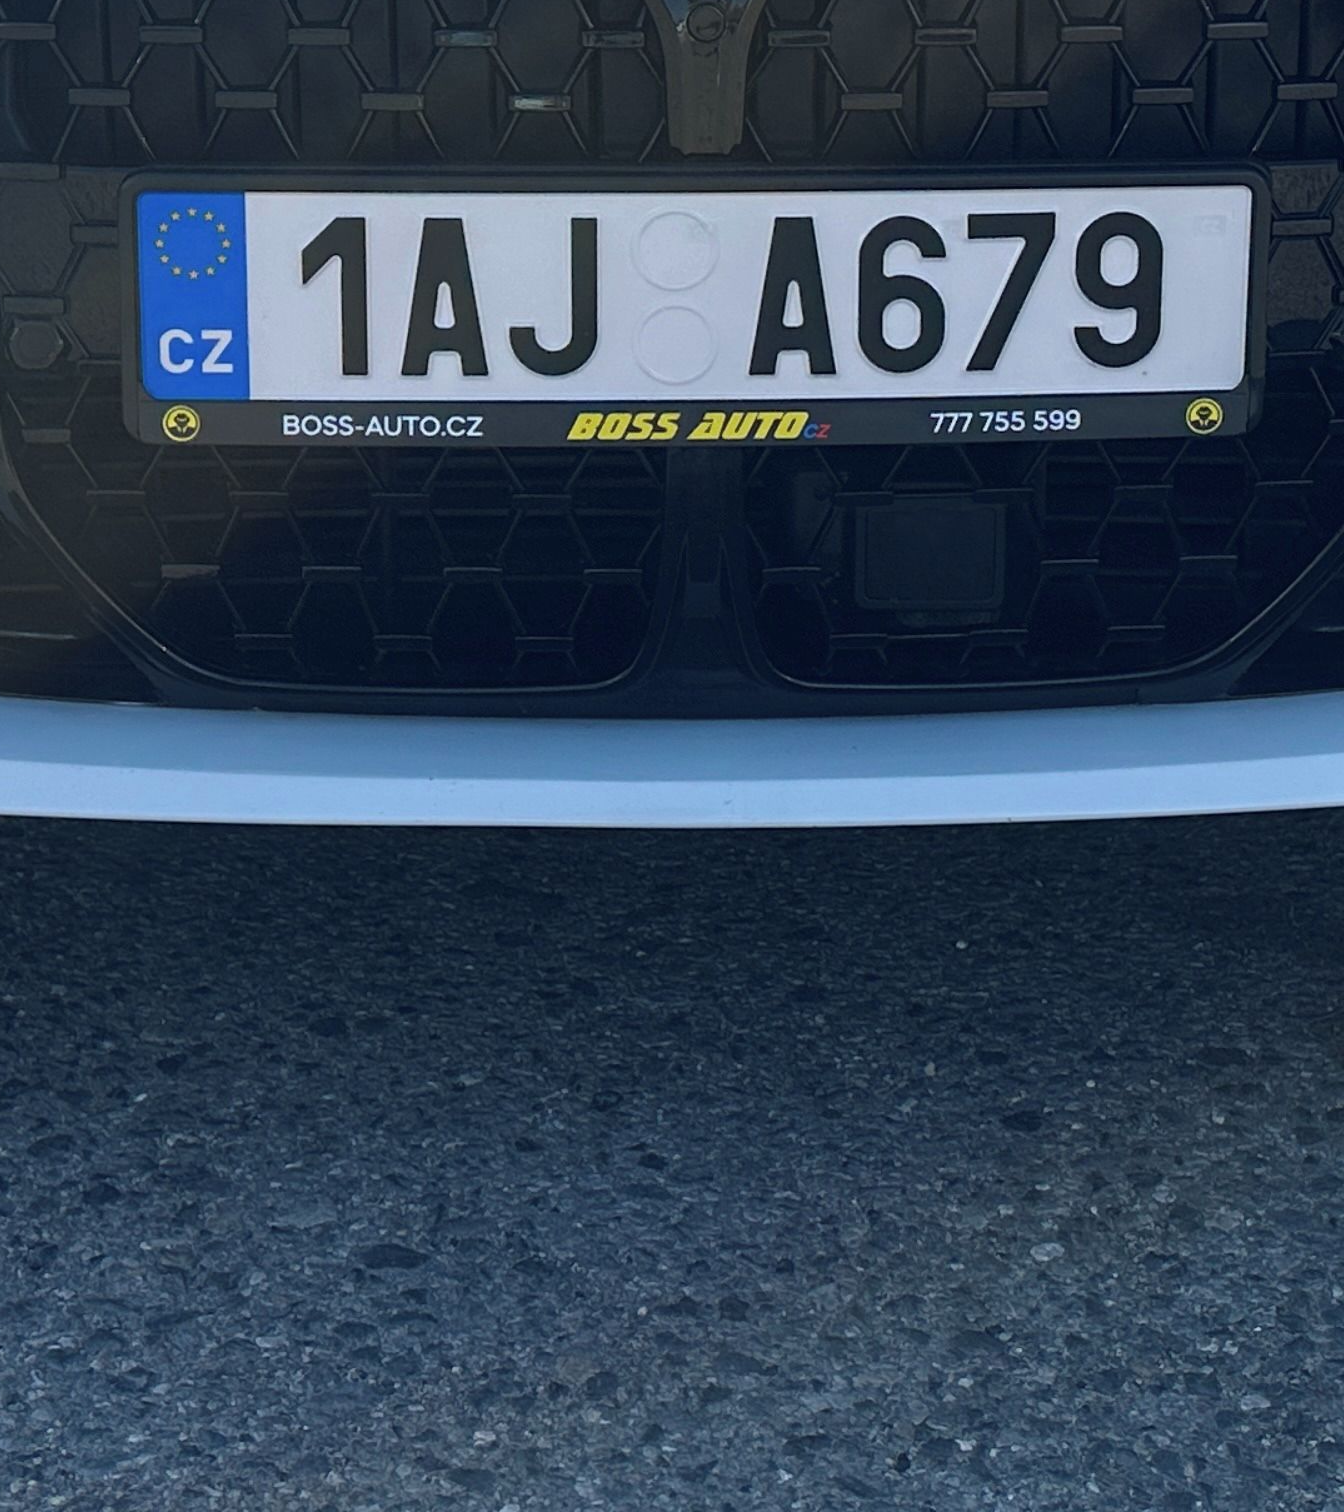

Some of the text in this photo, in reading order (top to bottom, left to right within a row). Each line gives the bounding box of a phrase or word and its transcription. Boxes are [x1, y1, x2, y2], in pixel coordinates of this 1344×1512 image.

[301, 212, 1163, 376] 1AJ A679
[159, 329, 234, 374] CZ
[282, 414, 484, 438] BOSS-AUTO.CZ
[566, 412, 682, 441] BOSS
[686, 411, 809, 441] AUTO
[930, 409, 1081, 433] 777 755 599
